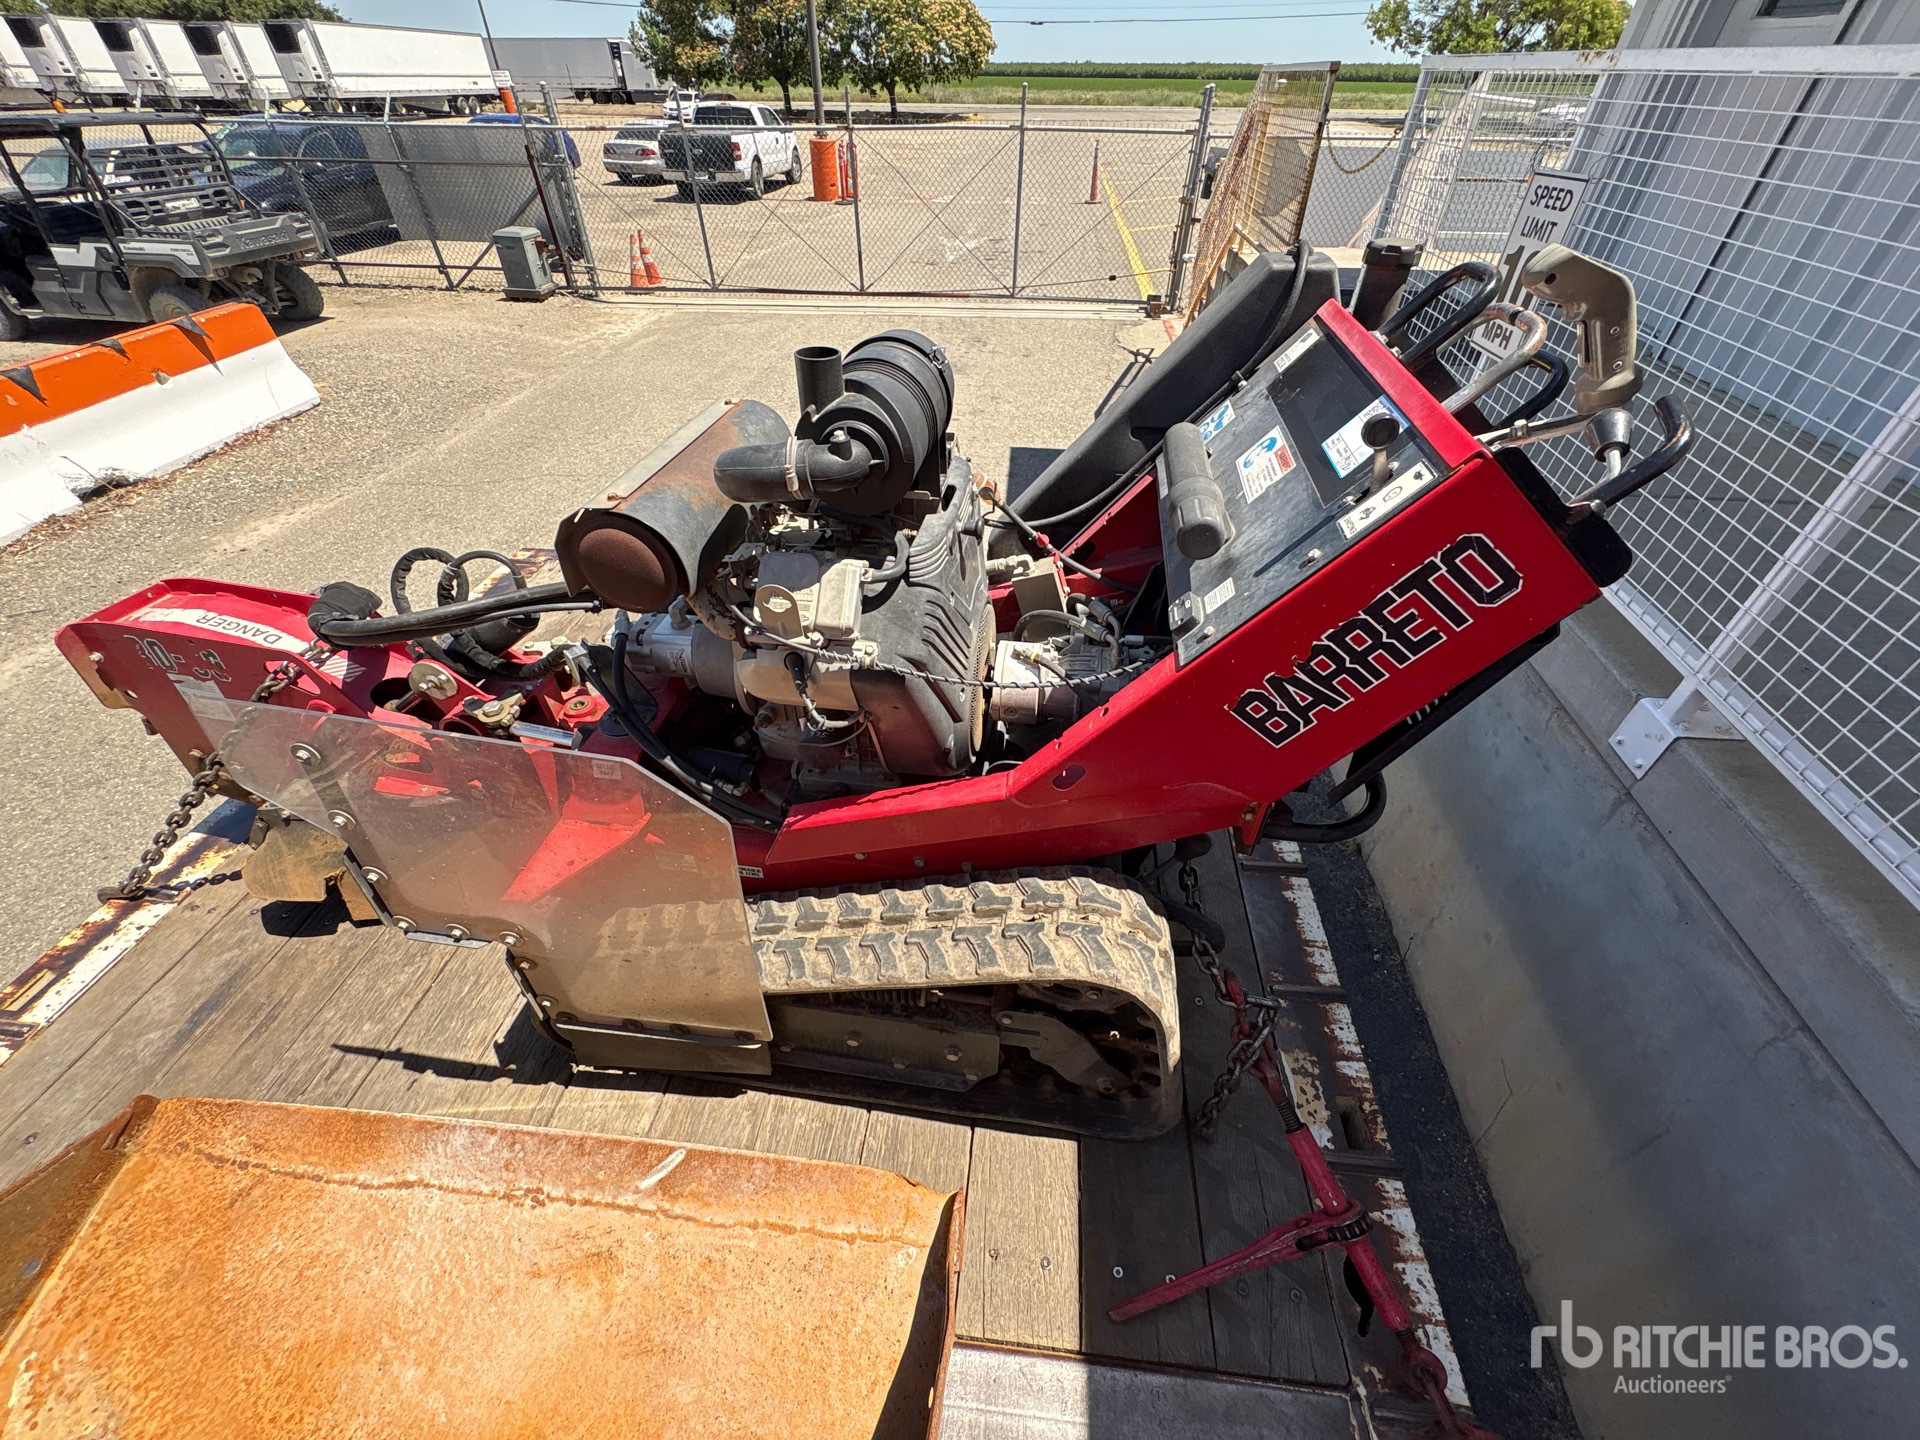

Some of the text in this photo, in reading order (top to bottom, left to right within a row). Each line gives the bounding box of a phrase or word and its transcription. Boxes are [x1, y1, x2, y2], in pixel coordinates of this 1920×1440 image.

[1530, 184, 1574, 212] SPEED
[236, 229, 290, 250] Kawasaki
[1520, 215, 1559, 244] LIMIT
[1495, 245, 1542, 311] 1
[1481, 321, 1514, 350] MPH
[195, 615, 284, 645] DANGER
[1224, 533, 1524, 748] BARRETO
